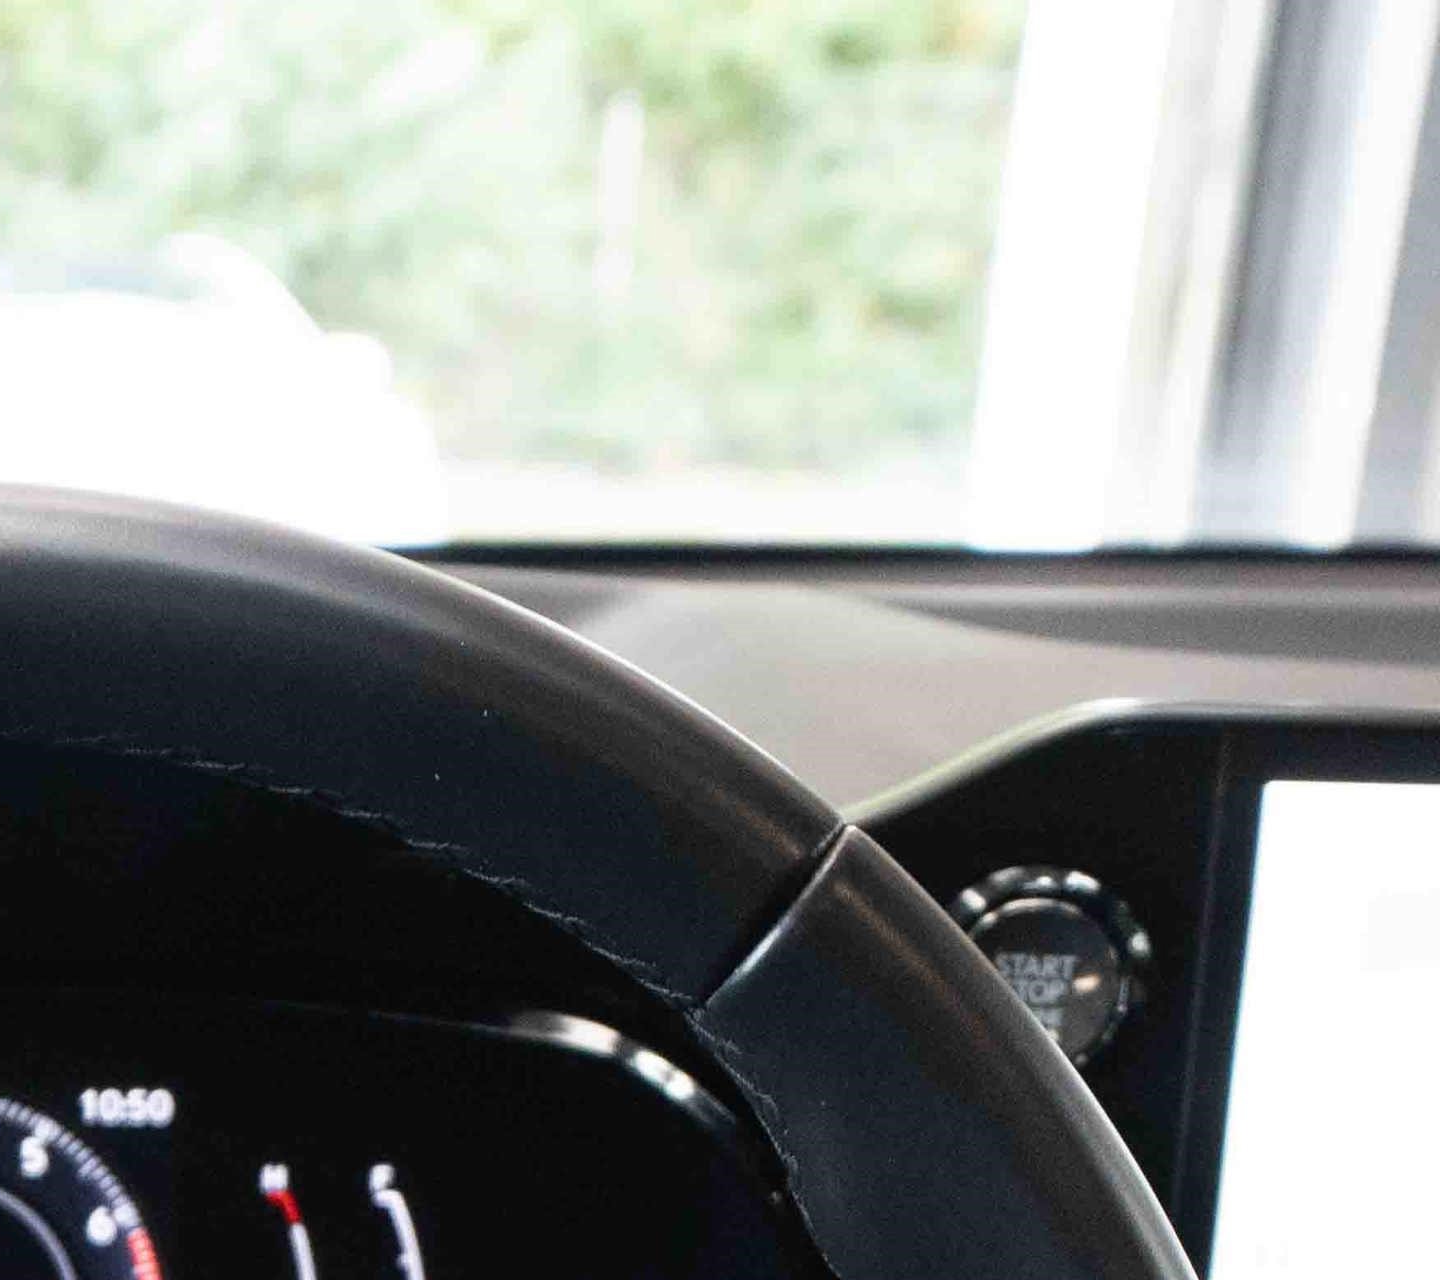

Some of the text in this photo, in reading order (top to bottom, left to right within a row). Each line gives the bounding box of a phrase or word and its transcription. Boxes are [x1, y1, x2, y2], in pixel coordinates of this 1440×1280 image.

[1011, 979, 1067, 1003] TOP
[80, 1087, 176, 1127] 10:50
[20, 1134, 49, 1177] 5
[86, 1205, 117, 1246] 6
